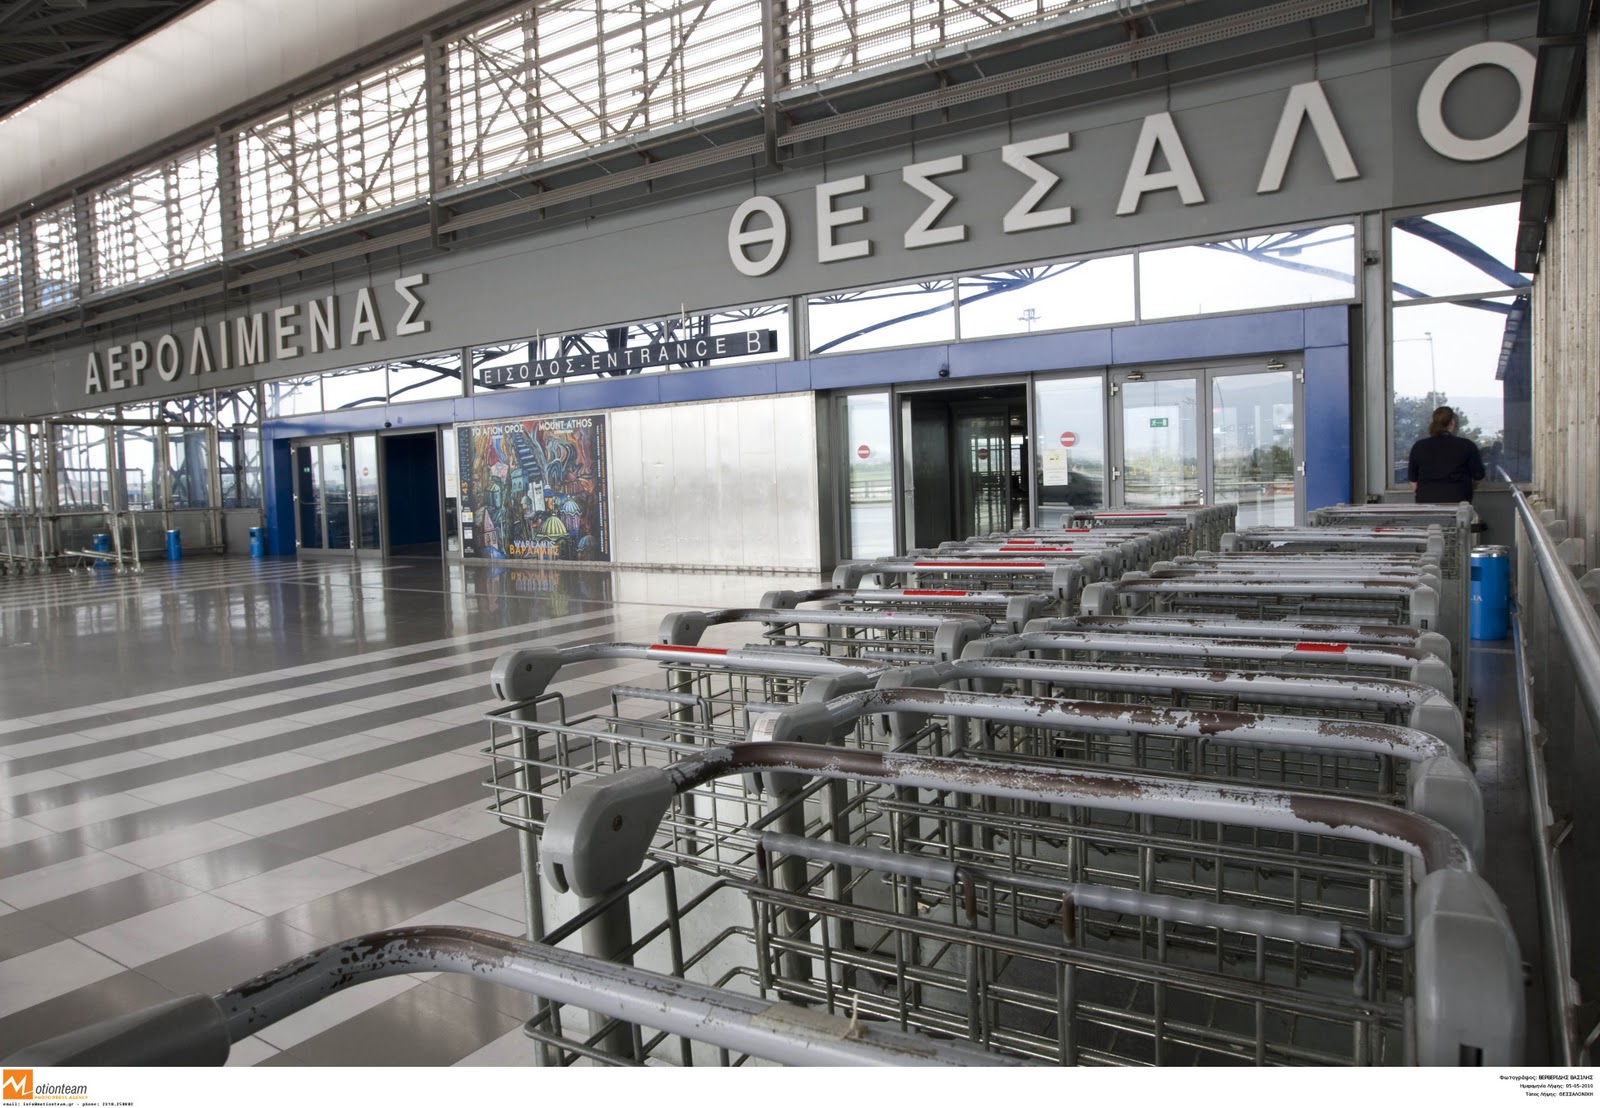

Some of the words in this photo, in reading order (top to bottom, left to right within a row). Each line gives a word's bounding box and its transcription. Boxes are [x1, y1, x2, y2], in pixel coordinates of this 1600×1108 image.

[85, 273, 430, 395] ΑΕΡΟΛΙΜΕΝΑΣ
[746, 330, 762, 353] B
[471, 428, 481, 436] ΤΟ
[482, 426, 503, 436] ΑΓΙΟΝ
[504, 424, 524, 434] ΟΡΟΣ
[538, 421, 565, 431] MOUNT
[565, 418, 593, 429] ATHOS
